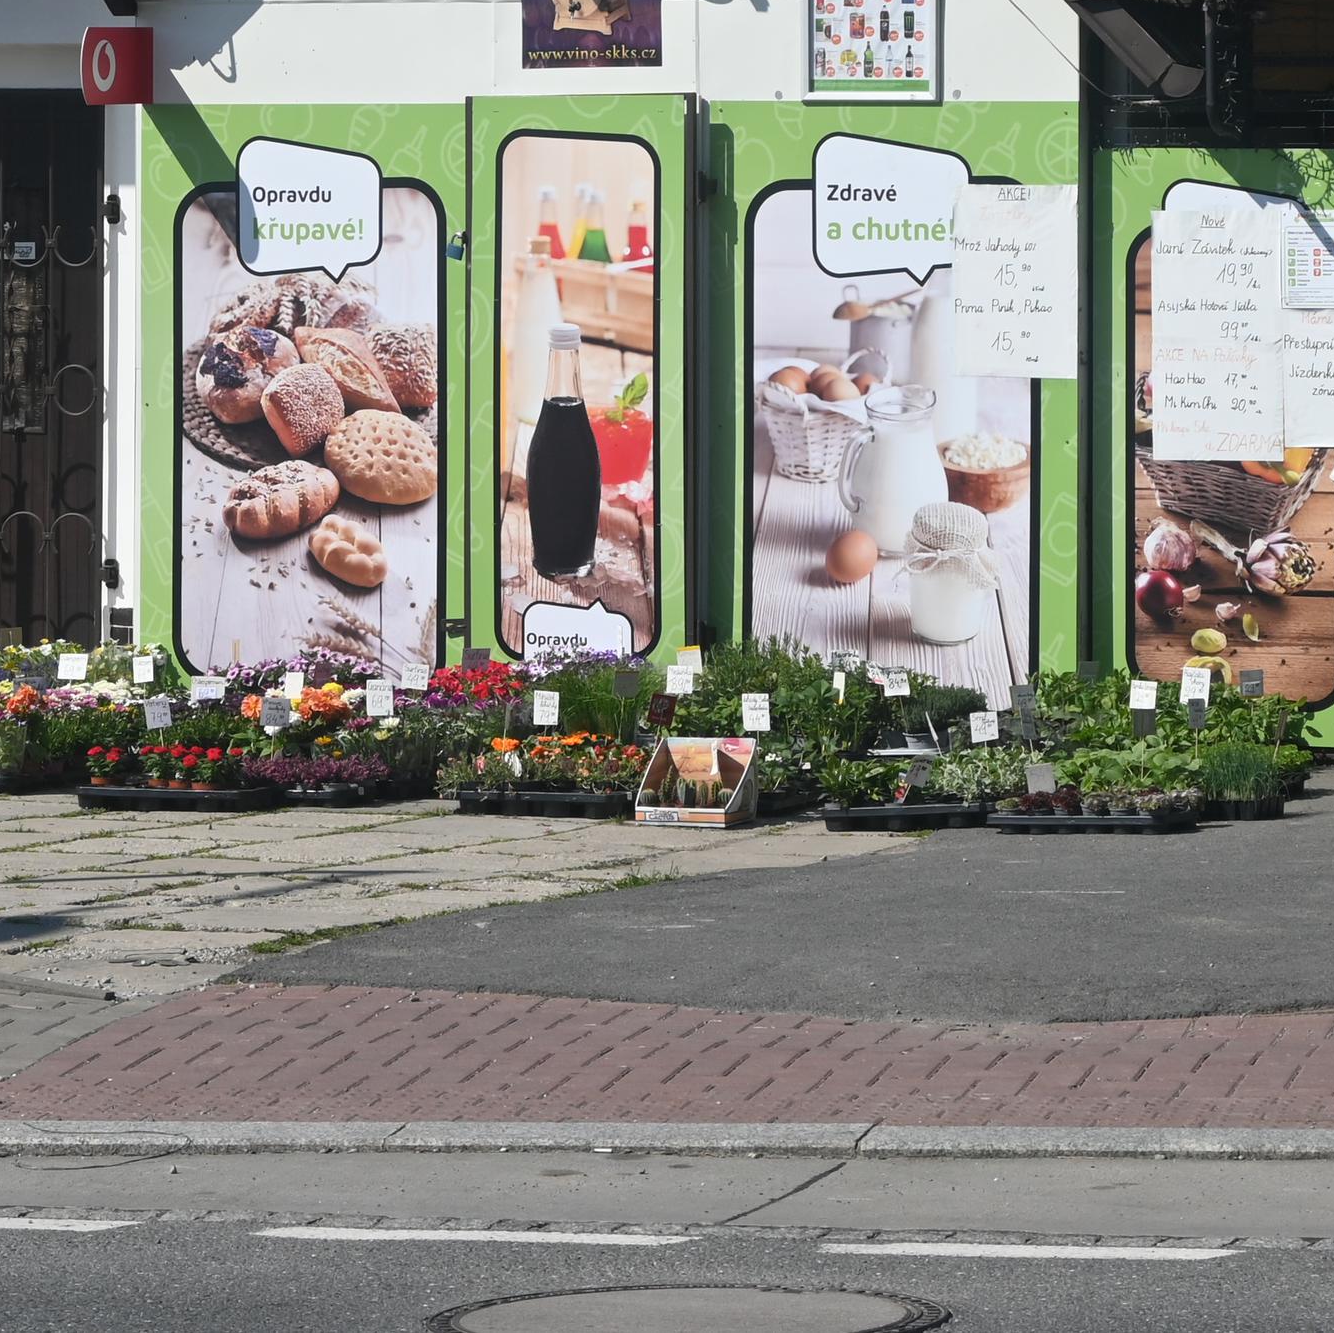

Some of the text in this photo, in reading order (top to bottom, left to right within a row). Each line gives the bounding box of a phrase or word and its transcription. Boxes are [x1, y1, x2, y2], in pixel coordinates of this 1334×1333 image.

[528, 45, 657, 60] www.vino-skks.cz
[252, 185, 332, 207] Opravdu
[826, 183, 898, 202] Zdravé
[997, 186, 1032, 201] AKCE!
[1200, 214, 1226, 228] Nové
[252, 216, 364, 246] křupavé!
[826, 216, 955, 242] a chutné!
[984, 236, 1021, 259] Jahody
[1155, 240, 1185, 255] Jarní
[1157, 298, 1196, 313] Asijská
[526, 632, 588, 647] Opravdu
